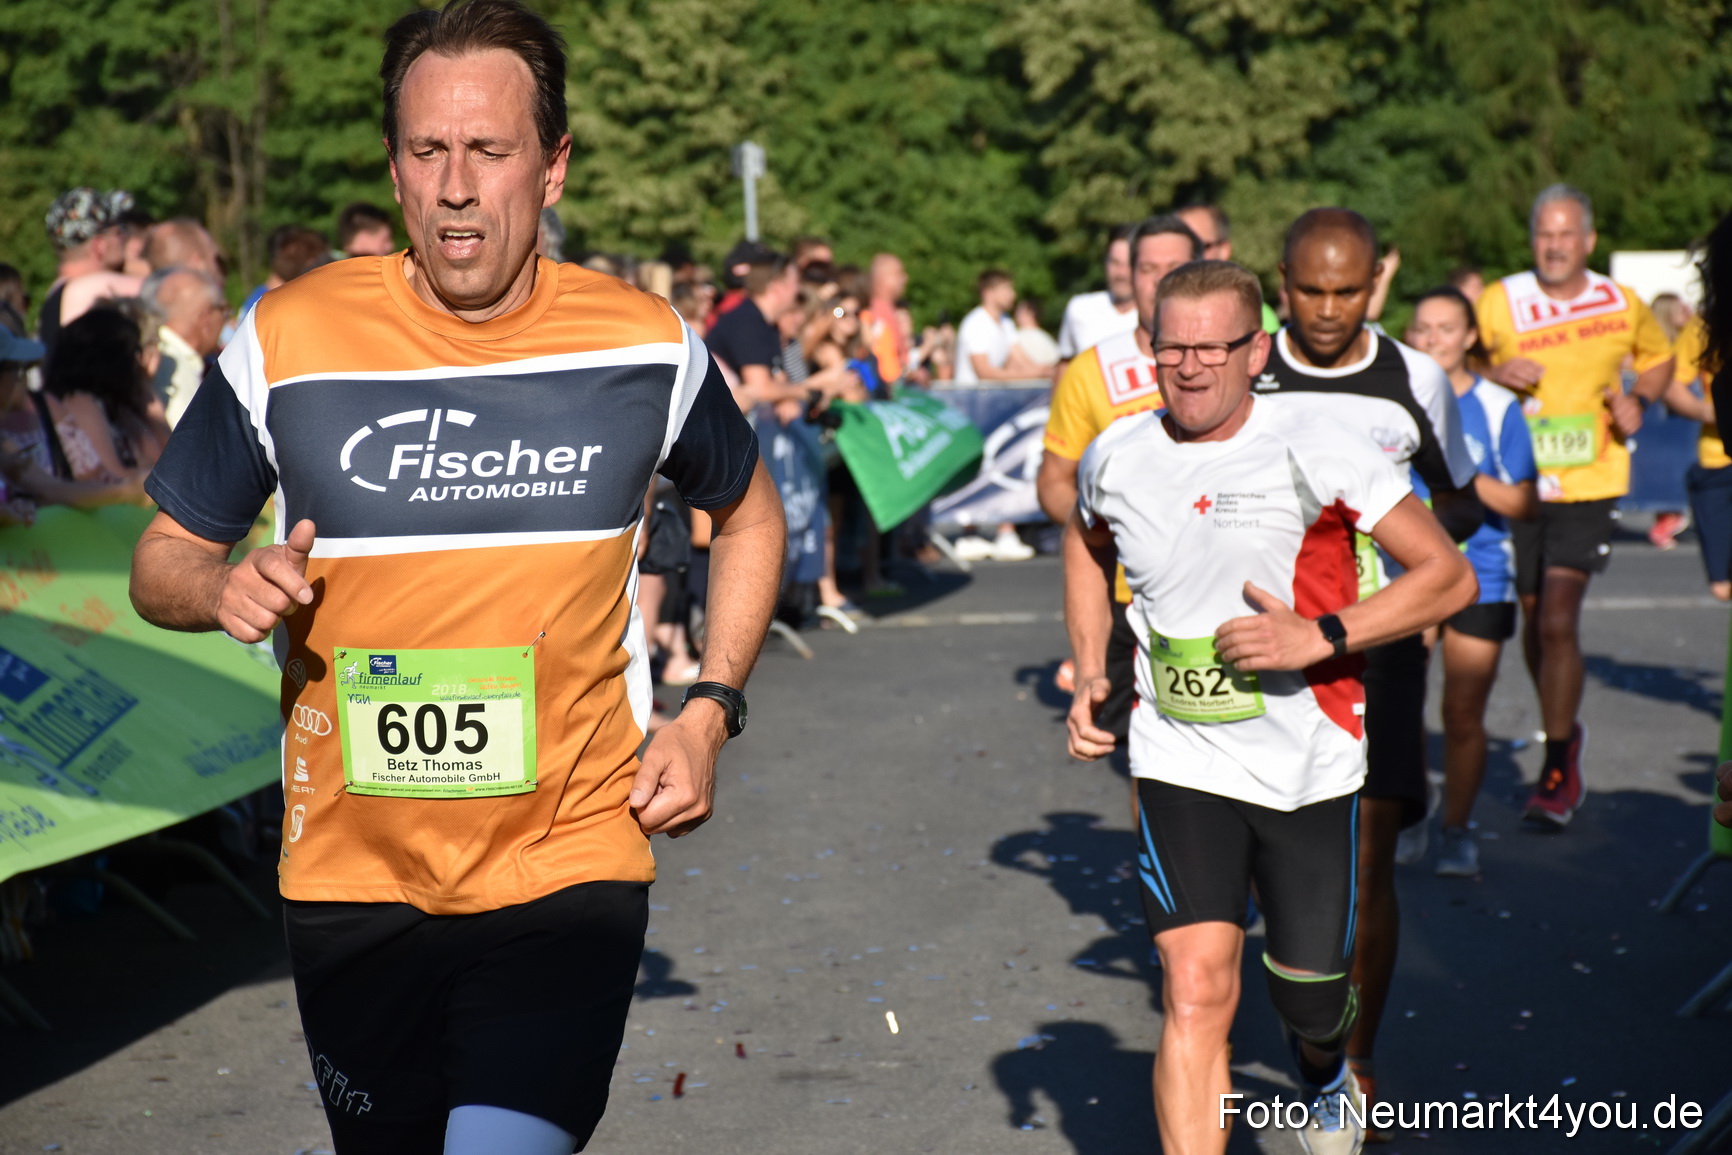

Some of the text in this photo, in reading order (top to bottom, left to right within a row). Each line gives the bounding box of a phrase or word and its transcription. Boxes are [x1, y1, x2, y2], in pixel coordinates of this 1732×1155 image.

[388, 439, 602, 480] Fischer
[408, 479, 587, 502] AUTOMOBILE
[1213, 518, 1260, 529] Norbert
[359, 672, 423, 685] firmenlauf
[1166, 666, 1229, 697] 262
[432, 684, 467, 696] 2018
[377, 703, 488, 755] 605
[294, 733, 308, 745] Audi
[387, 758, 483, 771] Betz Thomas
[372, 772, 500, 784] Fischer Automobile GmbH
